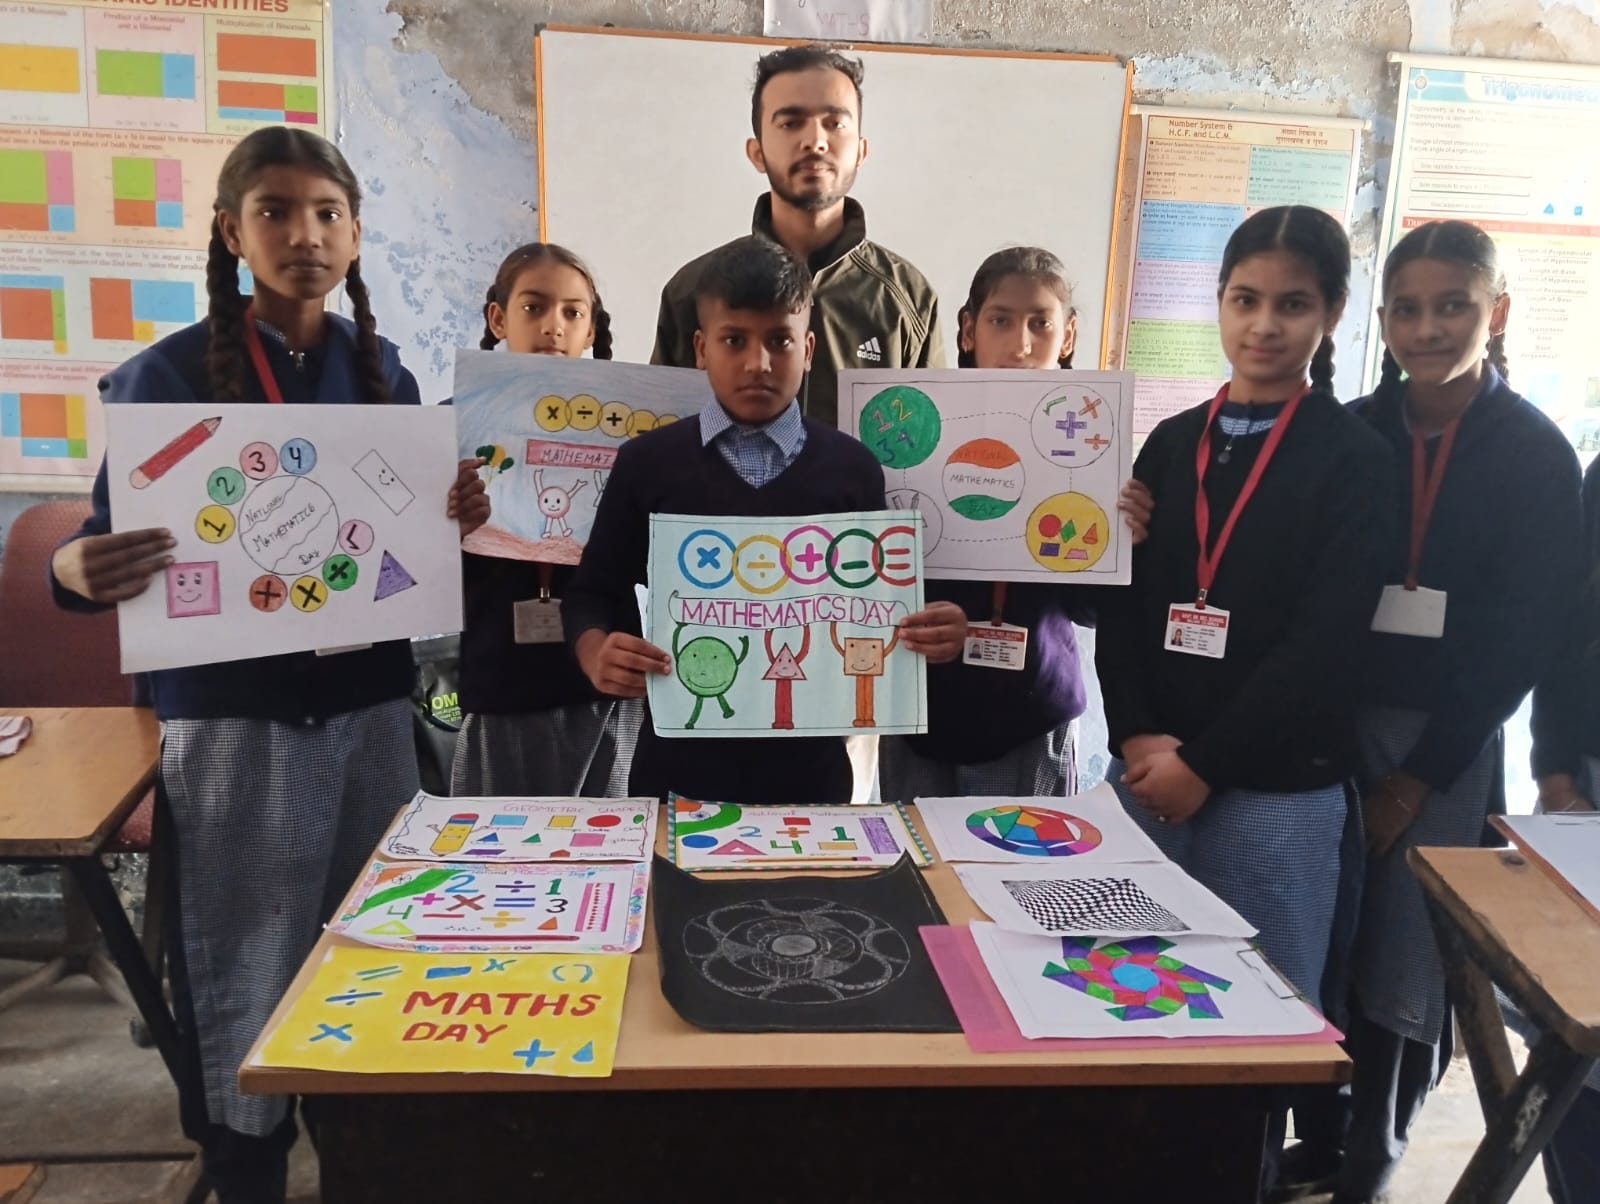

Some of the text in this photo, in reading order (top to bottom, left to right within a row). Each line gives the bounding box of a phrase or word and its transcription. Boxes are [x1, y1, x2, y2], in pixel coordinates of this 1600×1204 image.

[1168, 119, 1197, 128] Number
[1200, 121, 1225, 131] System
[1168, 129, 1191, 137] H.C.F.
[1208, 131, 1231, 139] L.C.M.
[857, 349, 881, 361] adidas
[872, 397, 912, 432] 1 2
[542, 449, 617, 465] MATHEMAT
[951, 473, 1015, 489] MATHEMATICS
[203, 446, 302, 538] 1 2 3 4
[298, 550, 320, 566] DAY
[681, 595, 898, 628] MATHEMATICS DAY
[504, 803, 585, 814] GEOMETRIC
[736, 825, 856, 841] 2 1
[769, 839, 803, 854] 4
[444, 874, 564, 895] 2 1
[386, 898, 569, 920] 4 3
[402, 991, 602, 1017] MATHS
[401, 1022, 509, 1044] DAY
